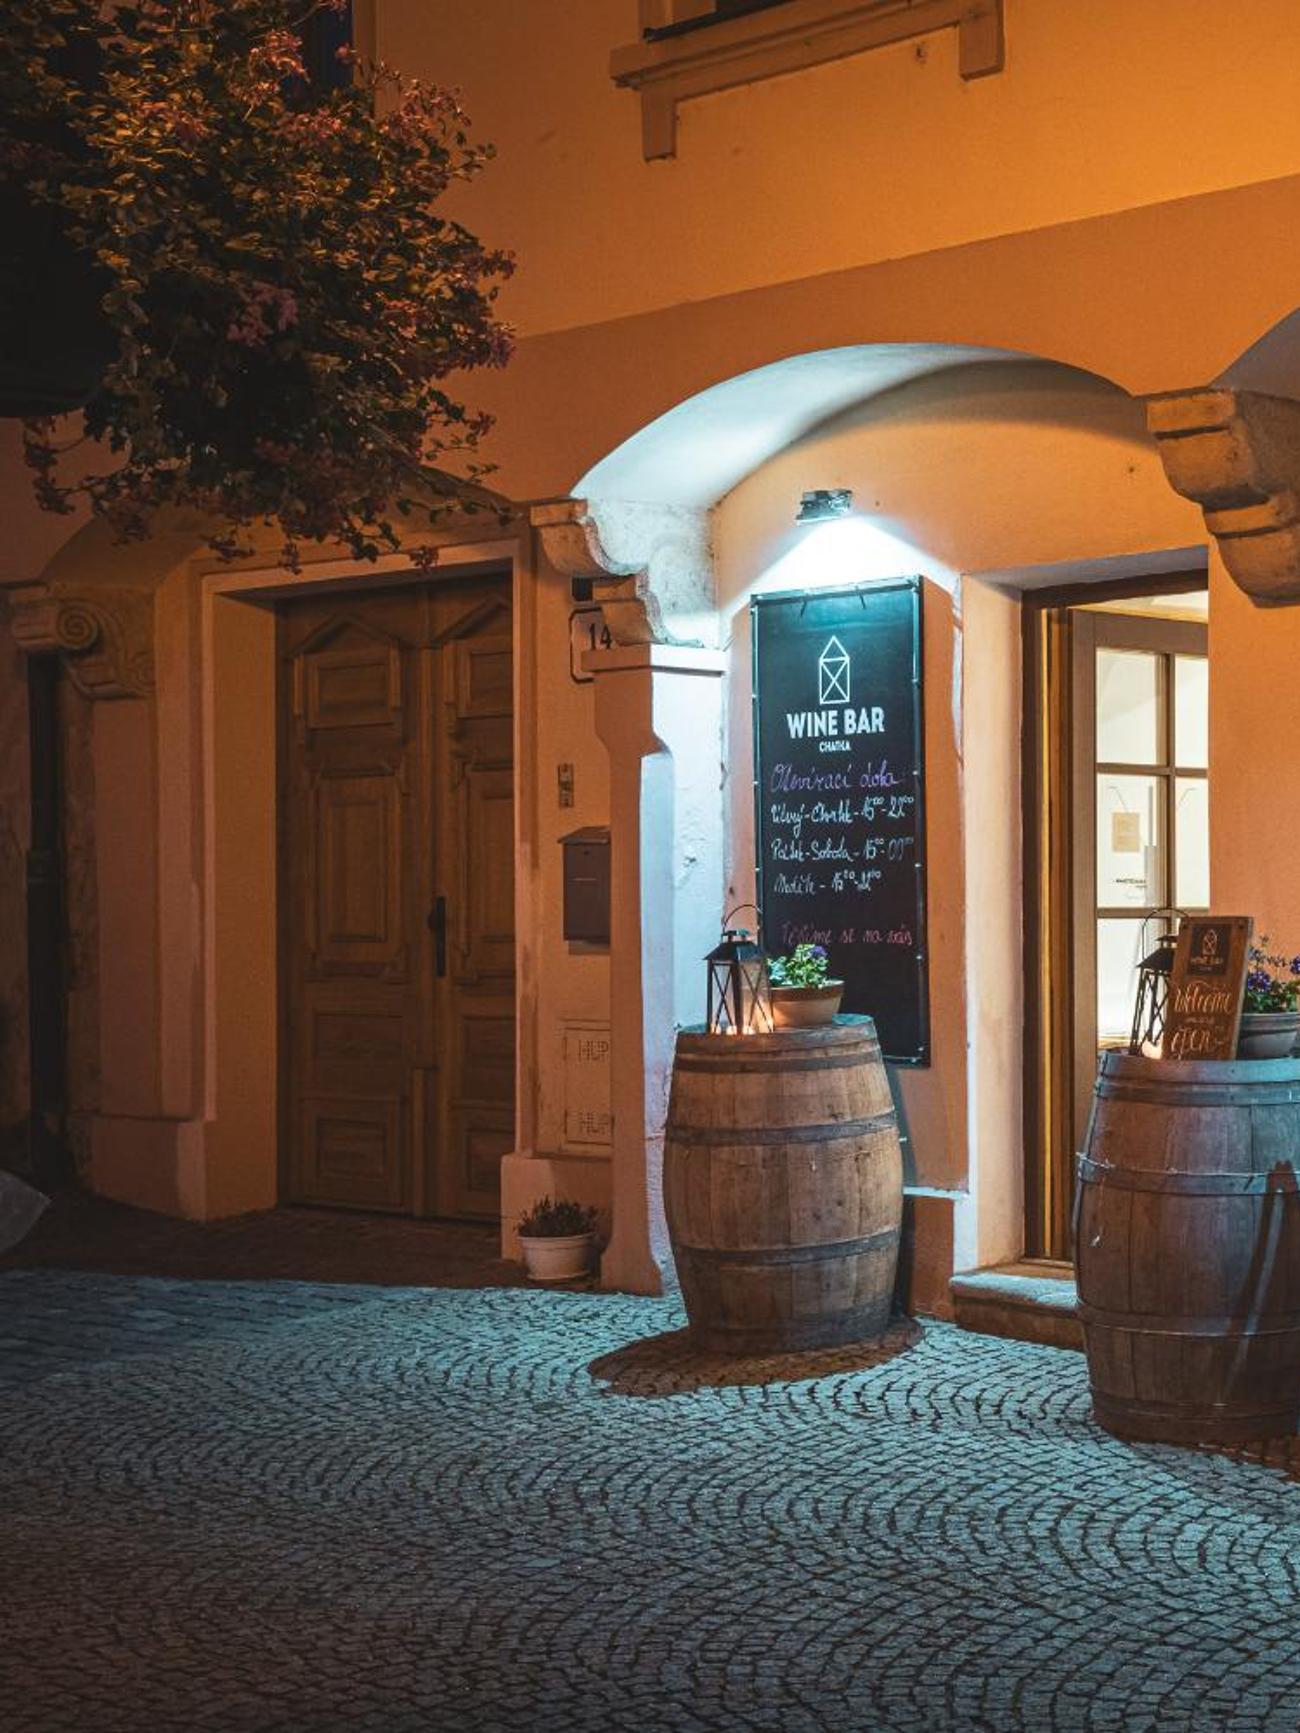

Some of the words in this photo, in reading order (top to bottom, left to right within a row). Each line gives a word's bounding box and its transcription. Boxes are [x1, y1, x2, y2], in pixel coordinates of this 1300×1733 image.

[589, 622, 612, 650] 14
[786, 709, 838, 739] WINE
[844, 706, 885, 735] BAR
[819, 740, 851, 753] CHATKA
